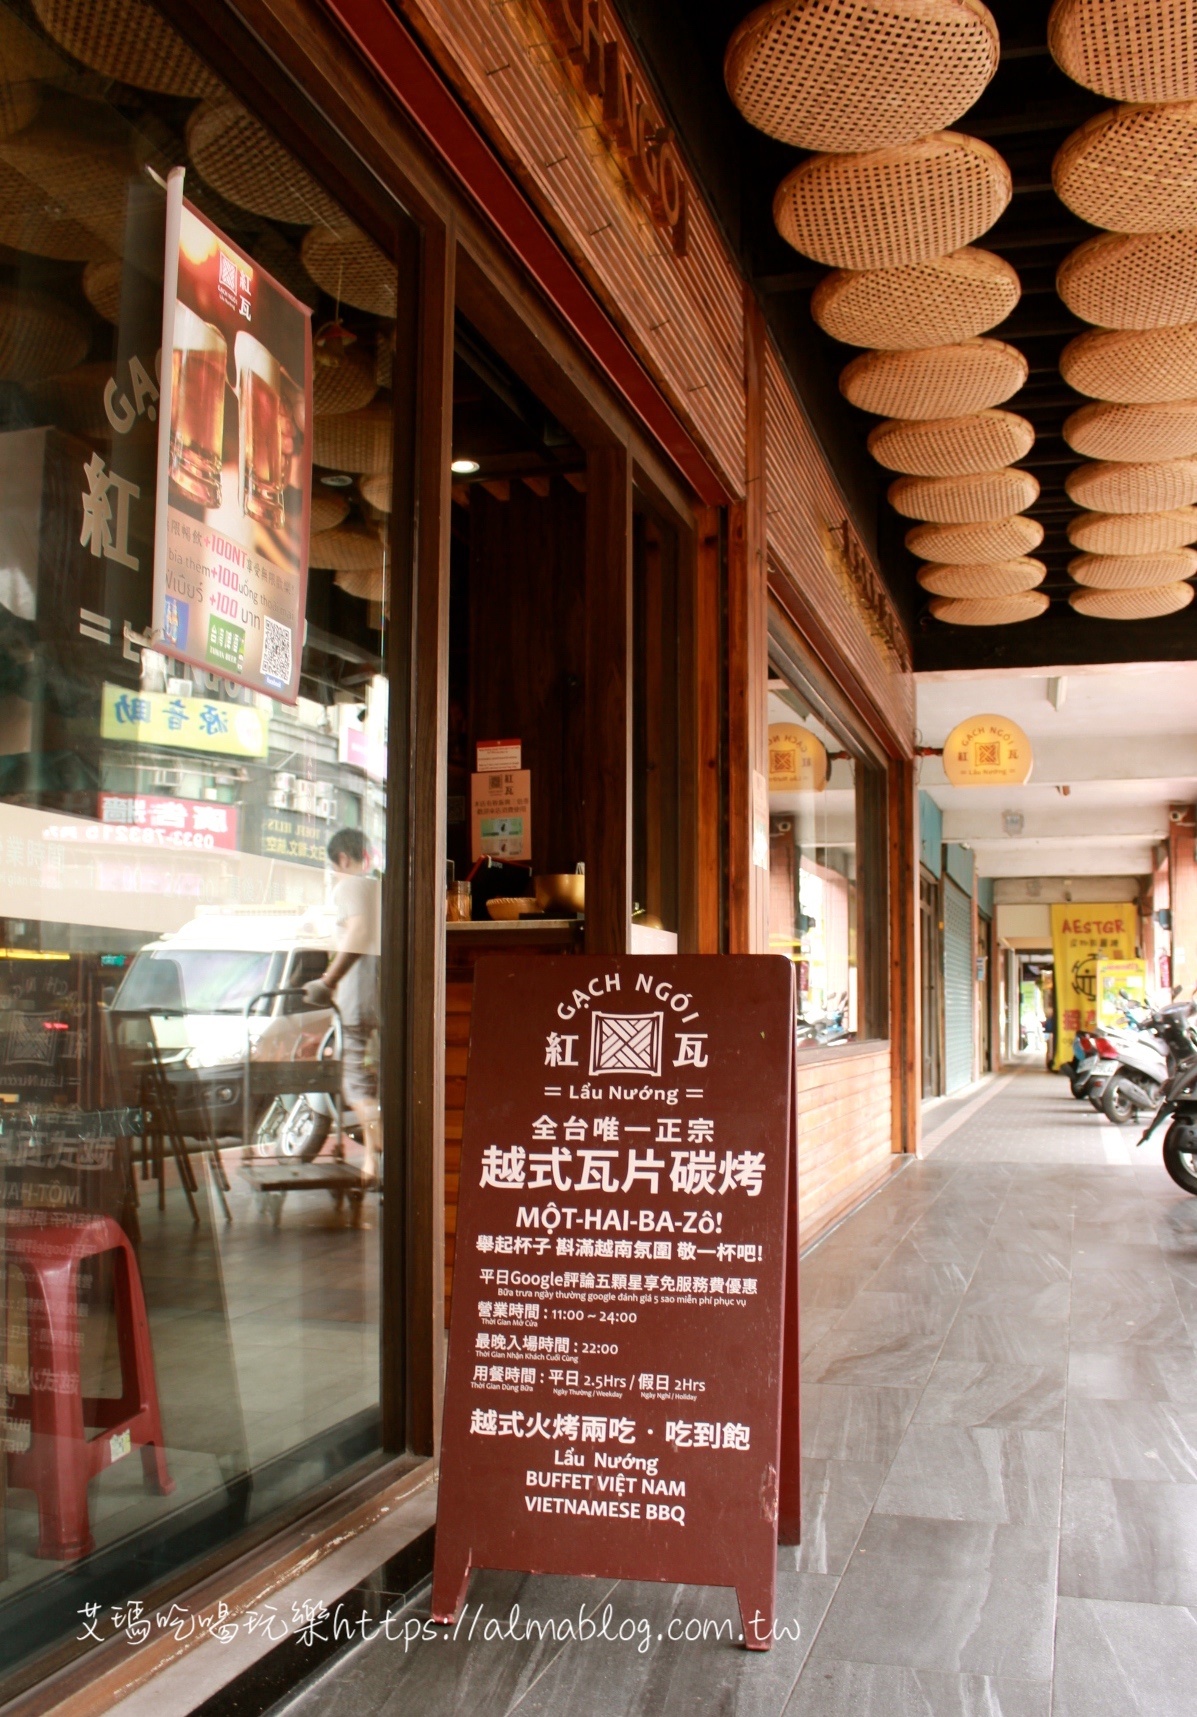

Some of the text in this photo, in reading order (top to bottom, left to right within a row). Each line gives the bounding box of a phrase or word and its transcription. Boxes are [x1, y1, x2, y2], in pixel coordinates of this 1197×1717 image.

[79, 451, 140, 572] 紅
[557, 973, 699, 1024] GẠCH NGÓI
[545, 1032, 708, 1067] 紅 瓦
[570, 1082, 679, 1105] Lẩu Nướng
[532, 1115, 714, 1143] 全台唯一正宗
[479, 1145, 766, 1196] 越式瓦片碳烤
[476, 1235, 762, 1262] 舉起杯子 斟滿越南氛圍 敬一杯吧!
[588, 1292, 616, 1302] google
[618, 1293, 638, 1301] đánh
[640, 1294, 652, 1304] giá
[654, 1296, 658, 1304] 5
[699, 1296, 712, 1306] phí
[552, 1310, 584, 1320] 11:00
[600, 1311, 637, 1324] 24:00
[582, 1343, 618, 1354] 22:00
[548, 1370, 578, 1386] 平日
[584, 1375, 626, 1389] 2.5Hrs
[638, 1373, 669, 1391] 假日
[675, 1379, 705, 1391] 2Hrs
[470, 1408, 636, 1444] 越式火烤兩吃
[666, 1420, 750, 1450] 吃到飽
[555, 1447, 659, 1477] Lẩu Nướng
[526, 1471, 685, 1497] BUFFET VIỆT NAM
[525, 1495, 685, 1526] VIETNAMESE BBQ
